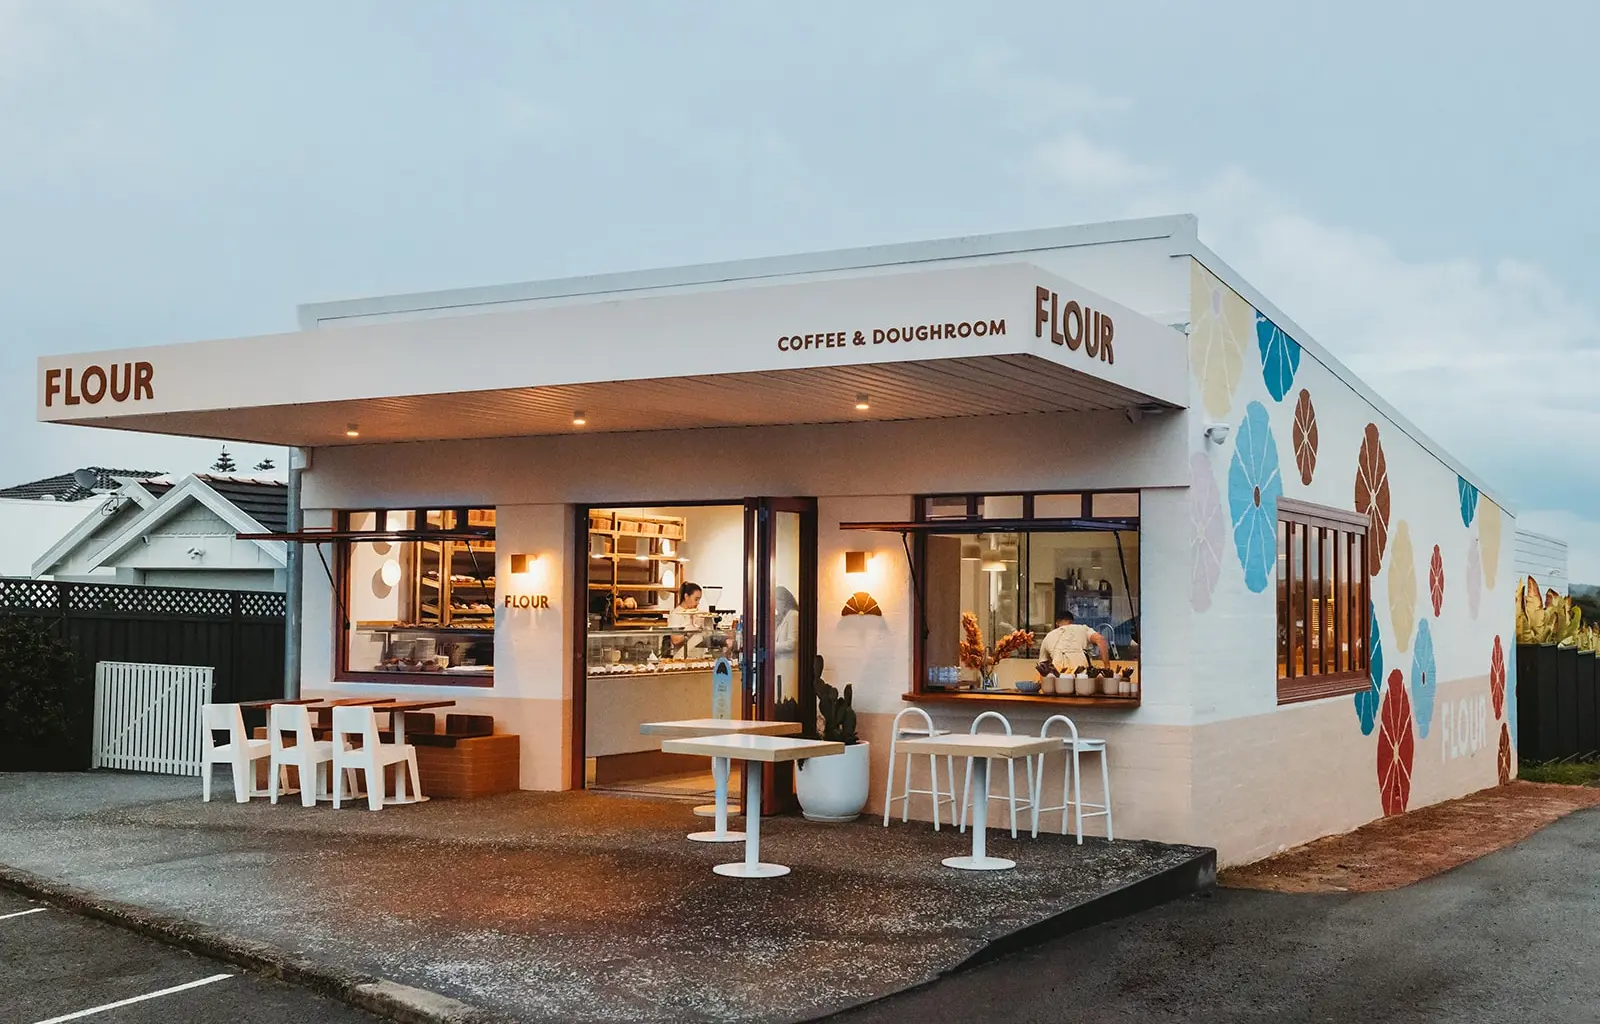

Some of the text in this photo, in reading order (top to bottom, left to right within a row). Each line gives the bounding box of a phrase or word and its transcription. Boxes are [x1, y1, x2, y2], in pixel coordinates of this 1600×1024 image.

[778, 319, 1007, 352] COFFEE & DOUGHROOM
[1035, 285, 1115, 365] FLOUR
[45, 361, 154, 407] FLOUR
[504, 594, 549, 609] FLOUR
[1441, 694, 1487, 765] FLOUR
